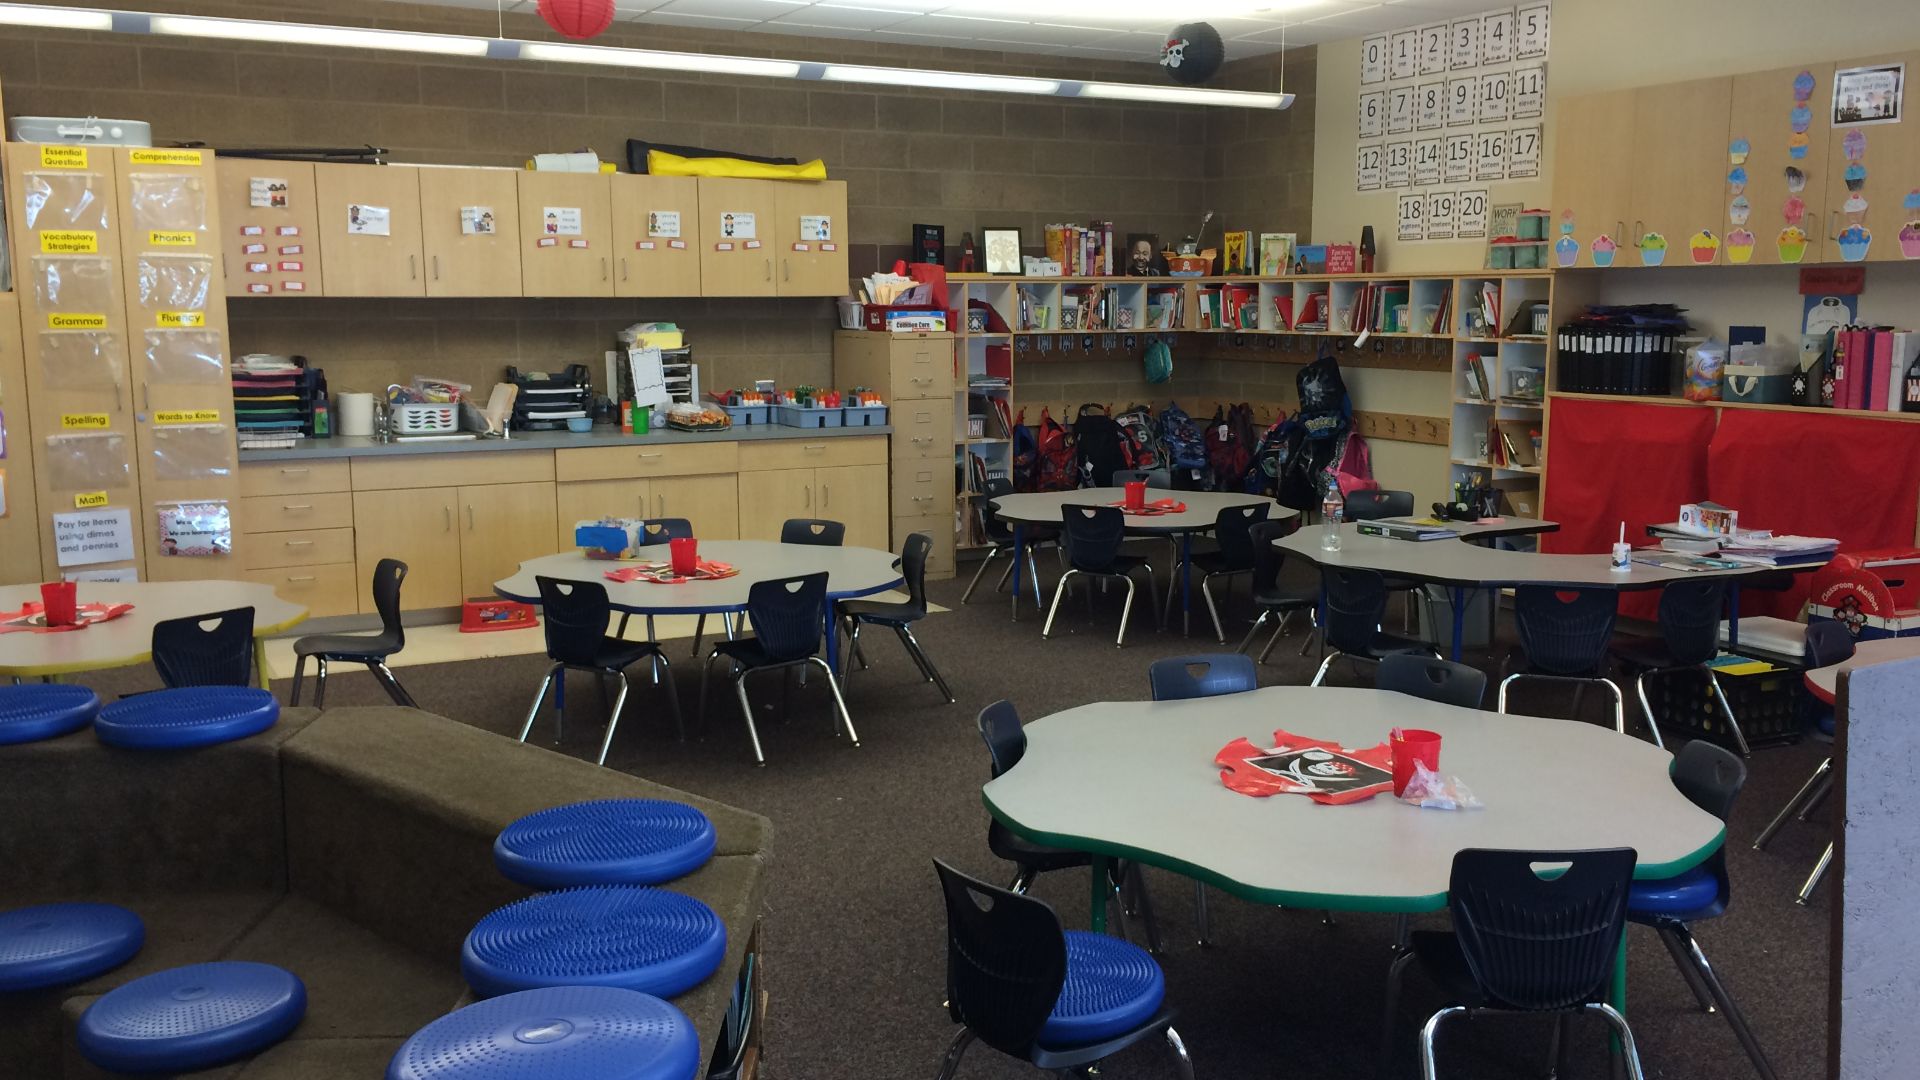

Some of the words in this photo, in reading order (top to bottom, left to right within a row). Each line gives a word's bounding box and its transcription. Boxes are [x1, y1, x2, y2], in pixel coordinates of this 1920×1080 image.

[1492, 21, 1504, 41] 4
[1526, 15, 1537, 36] 5
[1429, 34, 1438, 53] 2
[1460, 28, 1470, 48] 3
[1368, 44, 1378, 64] 0
[1400, 40, 1406, 58] 1
[1456, 84, 1466, 104] 9
[1484, 80, 1506, 101] 10
[1518, 74, 1538, 96] 11
[1368, 98, 1376, 117] 6
[1397, 94, 1406, 113] 7
[1426, 90, 1436, 108] 8
[45, 148, 82, 156] Essential
[1449, 141, 1468, 160] 15
[1482, 138, 1502, 158] 16
[1514, 134, 1536, 154] 17
[44, 158, 84, 166] Question
[132, 152, 200, 162] Comprehension
[1362, 150, 1378, 170] 12
[1390, 148, 1407, 166] 13
[1418, 144, 1437, 164] 14
[1403, 200, 1420, 220] 18
[1432, 198, 1452, 218] 19
[1462, 196, 1484, 216] 20
[43, 234, 94, 242] Vocabulary
[48, 242, 90, 250] Strategies
[153, 233, 192, 242] Phonics
[53, 316, 104, 326] Grammar
[162, 314, 200, 322] Fluency
[64, 416, 106, 426] Spelling
[184, 412, 193, 420] to
[194, 412, 218, 420] Know
[78, 496, 106, 506] Math
[59, 532, 84, 541] using
[86, 530, 114, 538] dimes
[60, 544, 80, 552] and
[82, 542, 119, 552] pennies
[1822, 582, 1854, 602] Classroom
[1856, 584, 1879, 612] Mailbox
